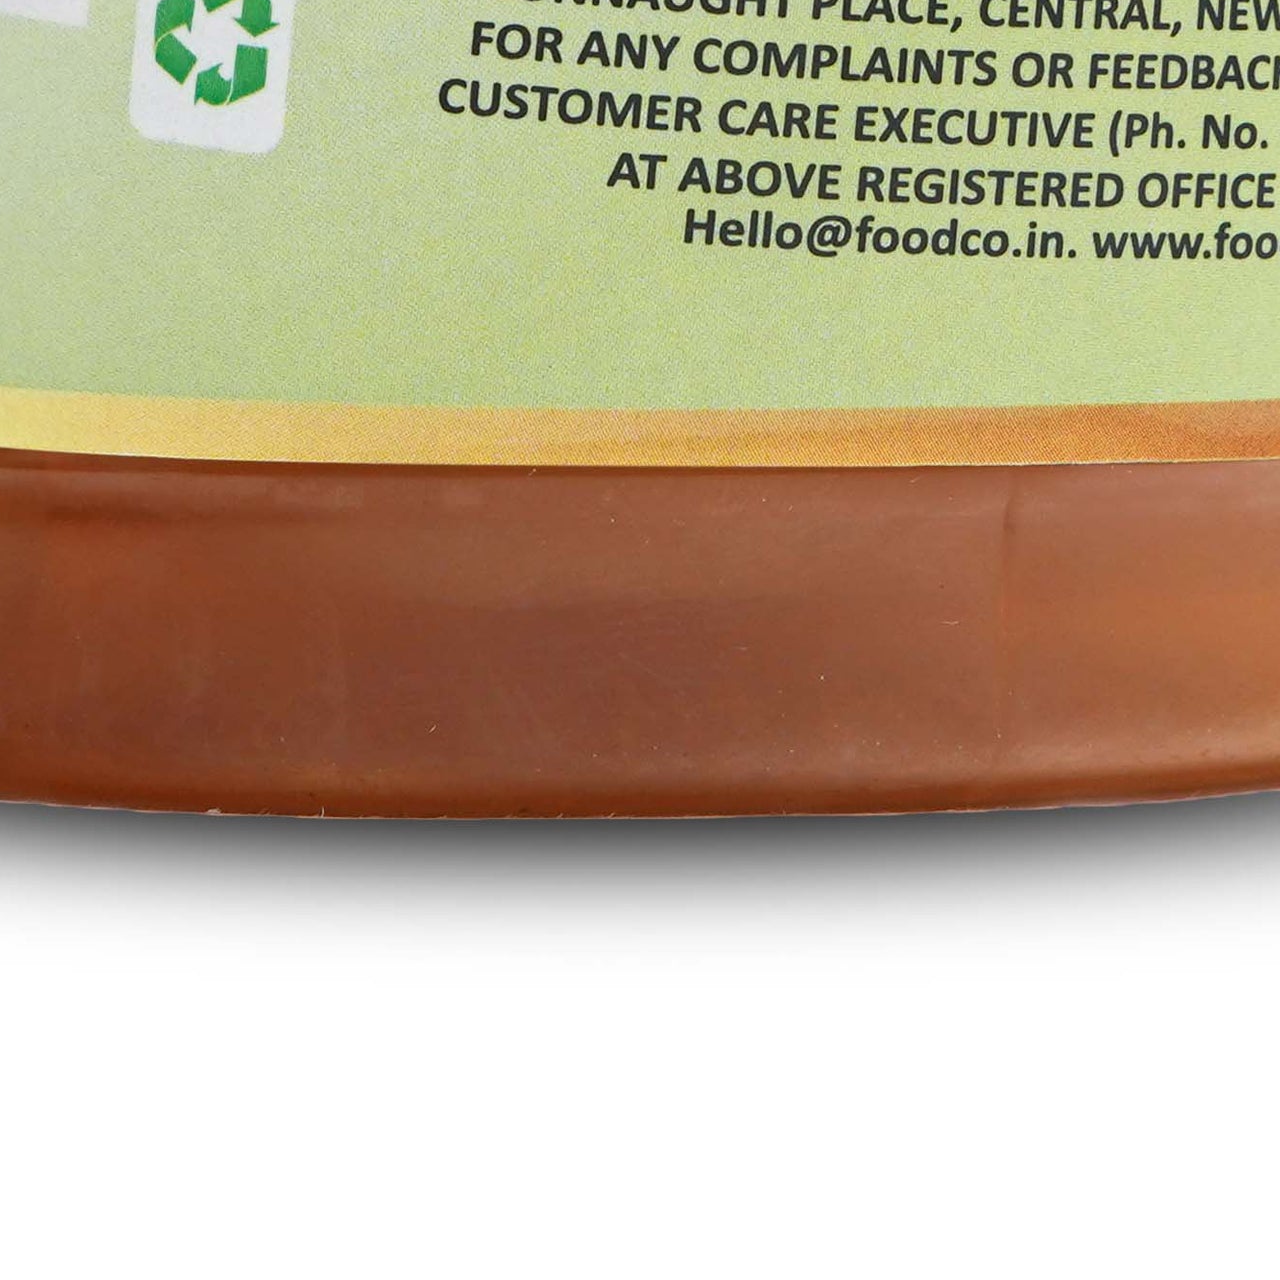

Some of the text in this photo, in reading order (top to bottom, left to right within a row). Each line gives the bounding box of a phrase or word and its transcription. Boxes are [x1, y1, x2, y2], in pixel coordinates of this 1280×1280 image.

[470, 20, 564, 64] FOR
[576, 30, 681, 72] ANY
[693, 37, 997, 87] COMPLAINTS
[1011, 51, 1074, 89] OR
[438, 78, 702, 133] CUSTOMER
[718, 99, 840, 140] CARE
[854, 106, 1096, 149] EXECUTIVE
[1109, 109, 1186, 158] (Ph.
[1201, 114, 1268, 150] No.
[606, 152, 668, 190] AT
[677, 157, 842, 201] ABOVE
[856, 165, 1124, 208] REGISTERED
[1137, 172, 1277, 209] OFFICE
[683, 208, 1077, 259] Hello@foodco.in.
